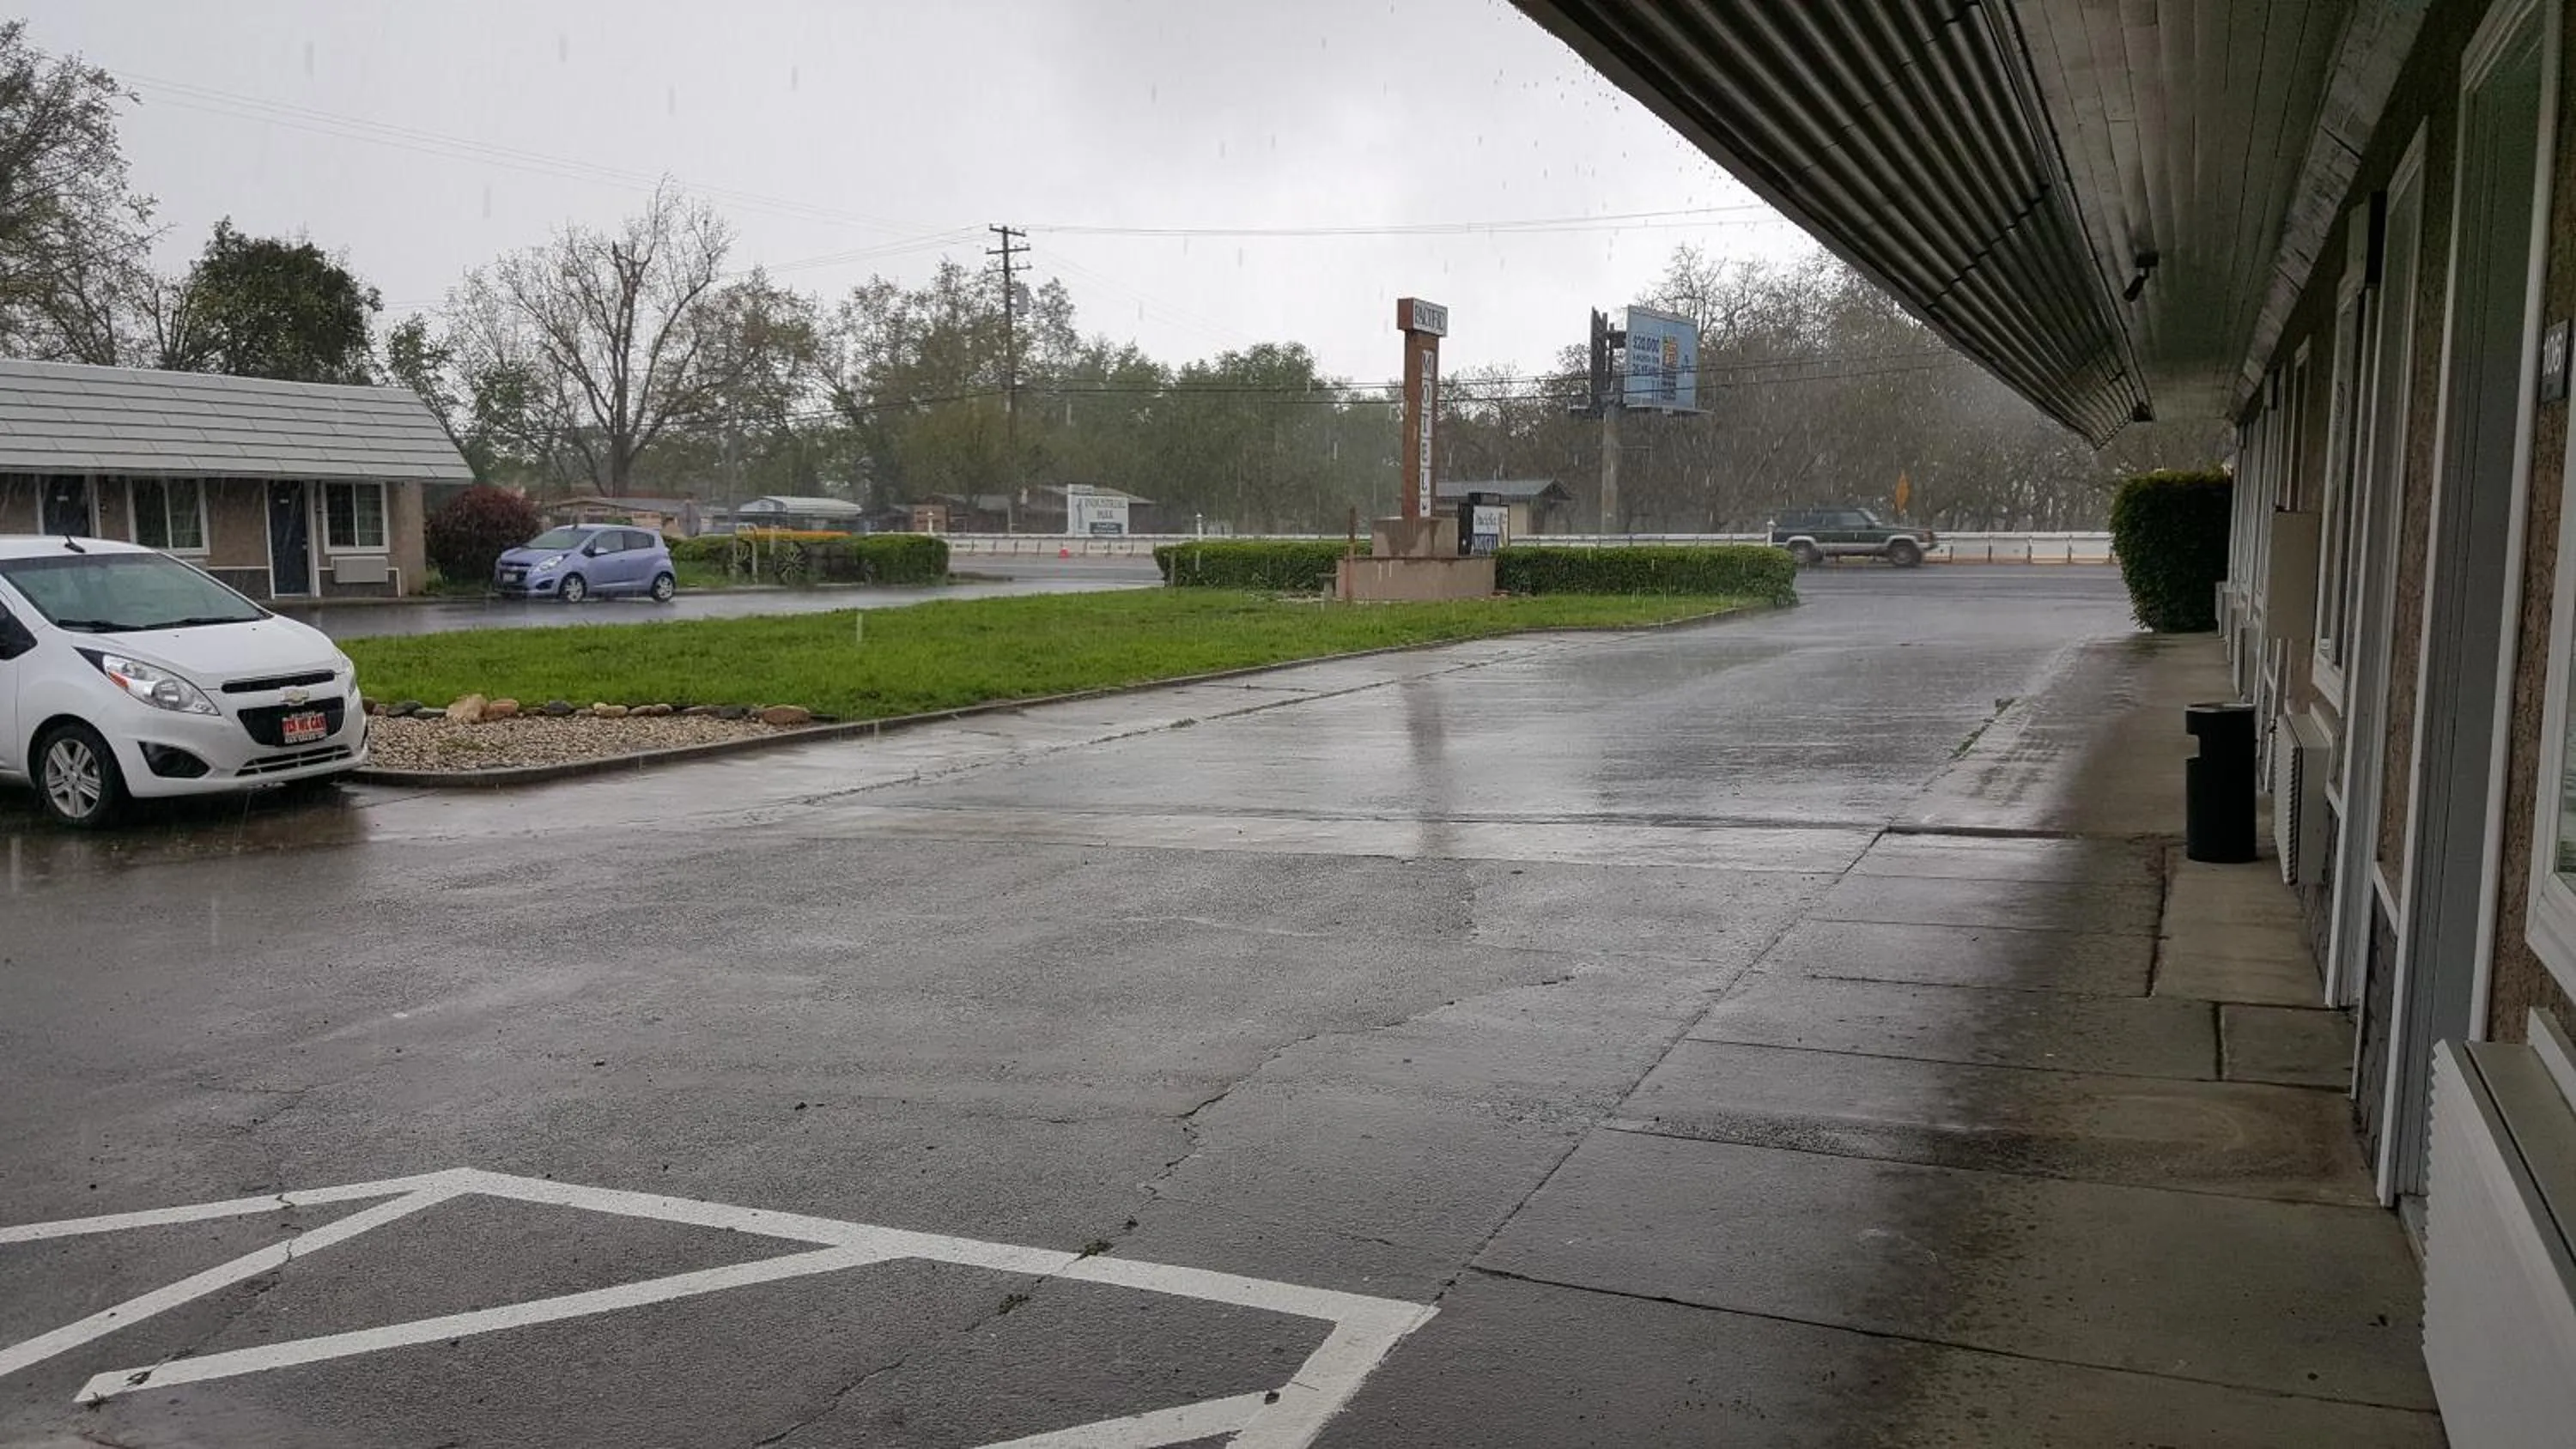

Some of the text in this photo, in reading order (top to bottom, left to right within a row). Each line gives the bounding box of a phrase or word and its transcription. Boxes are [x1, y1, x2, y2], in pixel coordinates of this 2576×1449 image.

[1415, 305, 1444, 330] PACIFIC
[2543, 332, 2563, 376] 106
[1421, 353, 1433, 492] MOTEL
